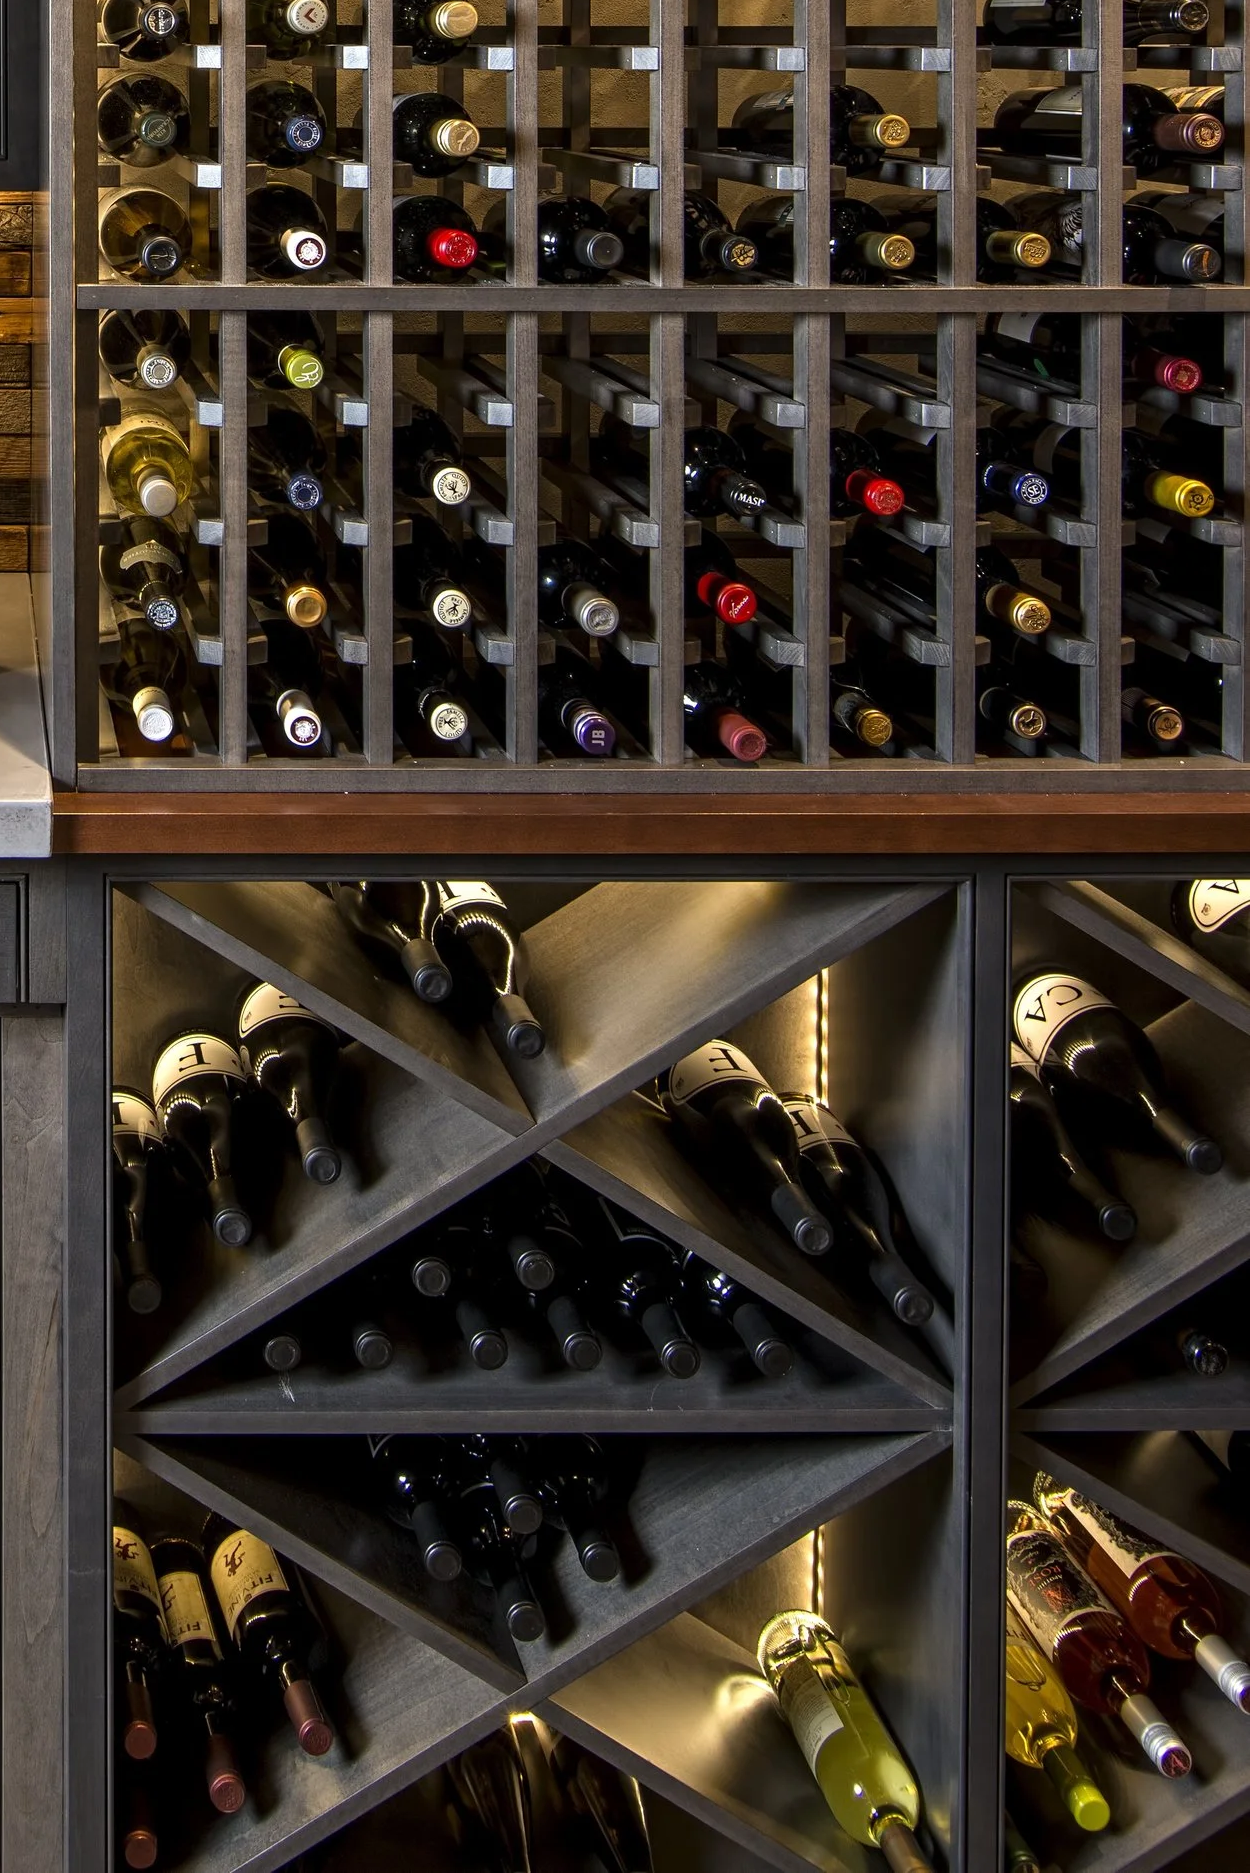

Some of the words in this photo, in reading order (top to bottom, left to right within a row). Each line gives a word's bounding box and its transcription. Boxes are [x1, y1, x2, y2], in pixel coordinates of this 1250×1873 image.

[1027, 484, 1041, 497] SE
[737, 492, 762, 507] MASI
[591, 729, 606, 747] JB
[226, 1573, 274, 1618] FITVINE
